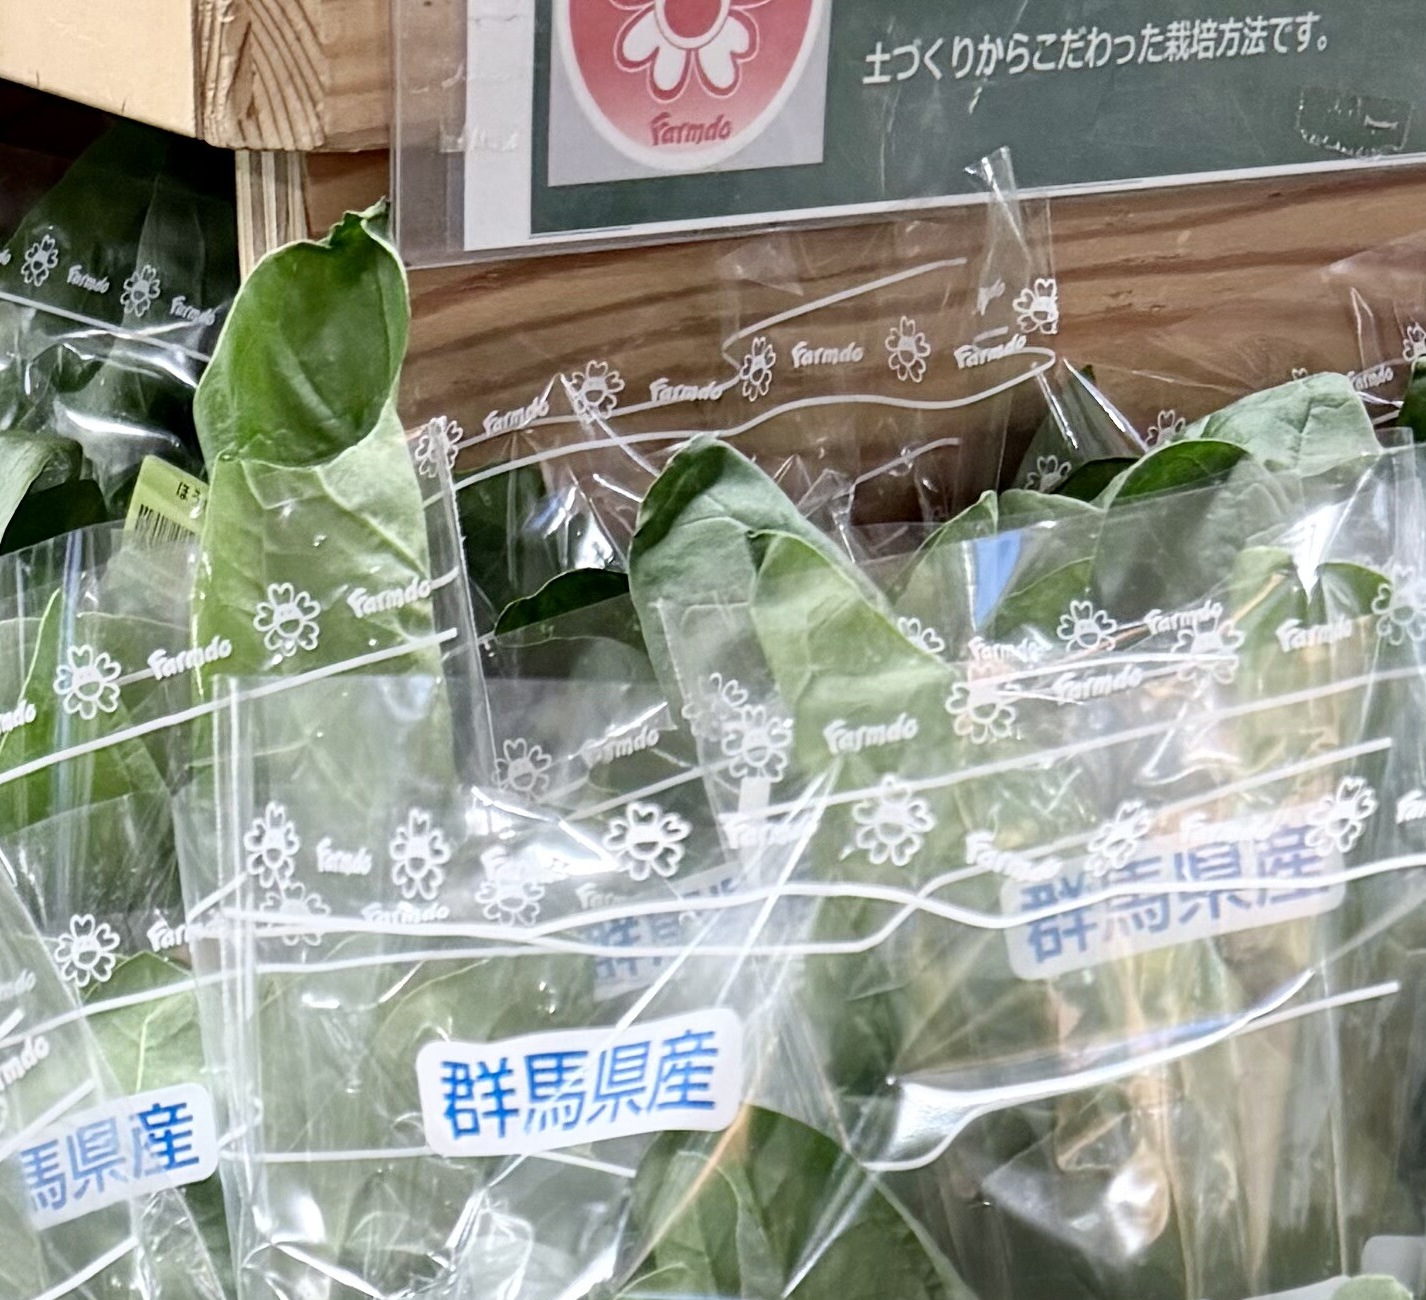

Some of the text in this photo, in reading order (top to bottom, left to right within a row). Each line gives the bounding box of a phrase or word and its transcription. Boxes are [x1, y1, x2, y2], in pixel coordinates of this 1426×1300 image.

[863, 12, 1330, 88] 土づくりからこだわった栽培方法です。
[650, 111, 733, 147] Farmdo
[67, 265, 110, 293] Farmdo
[170, 296, 215, 326] Farmdo
[792, 340, 864, 368] Farmdo
[955, 333, 1027, 371] Farmdo
[650, 376, 723, 405] Farmdo
[483, 396, 551, 435] Farmdo
[346, 579, 433, 619] Farmdo
[1276, 614, 1353, 654] Farmdo
[148, 636, 233, 680] Farmdo
[823, 713, 918, 756] Farmdo
[439, 1027, 720, 1142] 群馬県産
[20, 1101, 200, 1213] 馬県産
